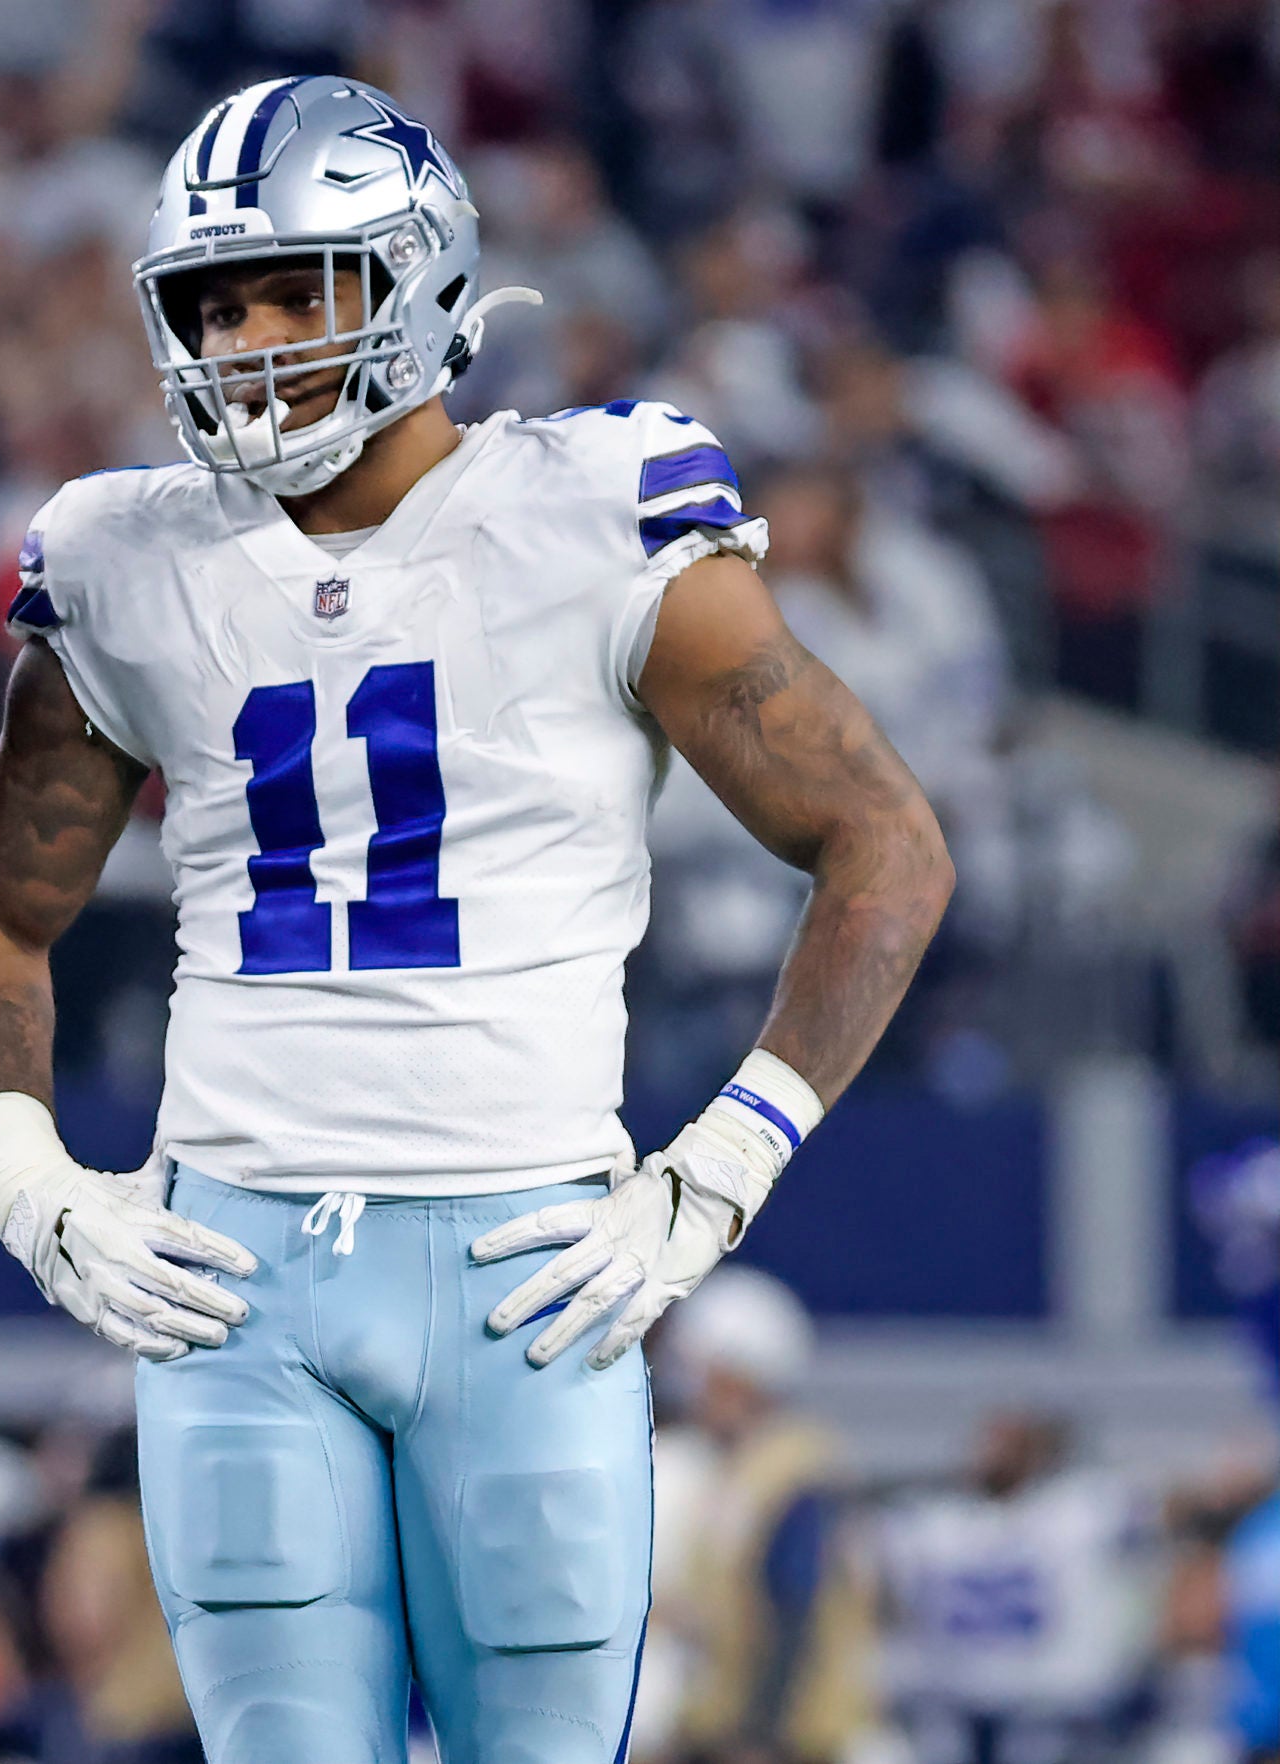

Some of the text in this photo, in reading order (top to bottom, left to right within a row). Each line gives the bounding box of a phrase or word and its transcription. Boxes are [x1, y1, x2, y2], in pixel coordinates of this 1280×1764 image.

[190, 223, 246, 240] COWBOYS
[319, 593, 344, 612] NFL
[232, 659, 461, 975] 11
[739, 1090, 761, 1106] WAY
[759, 1128, 780, 1151] FIND
